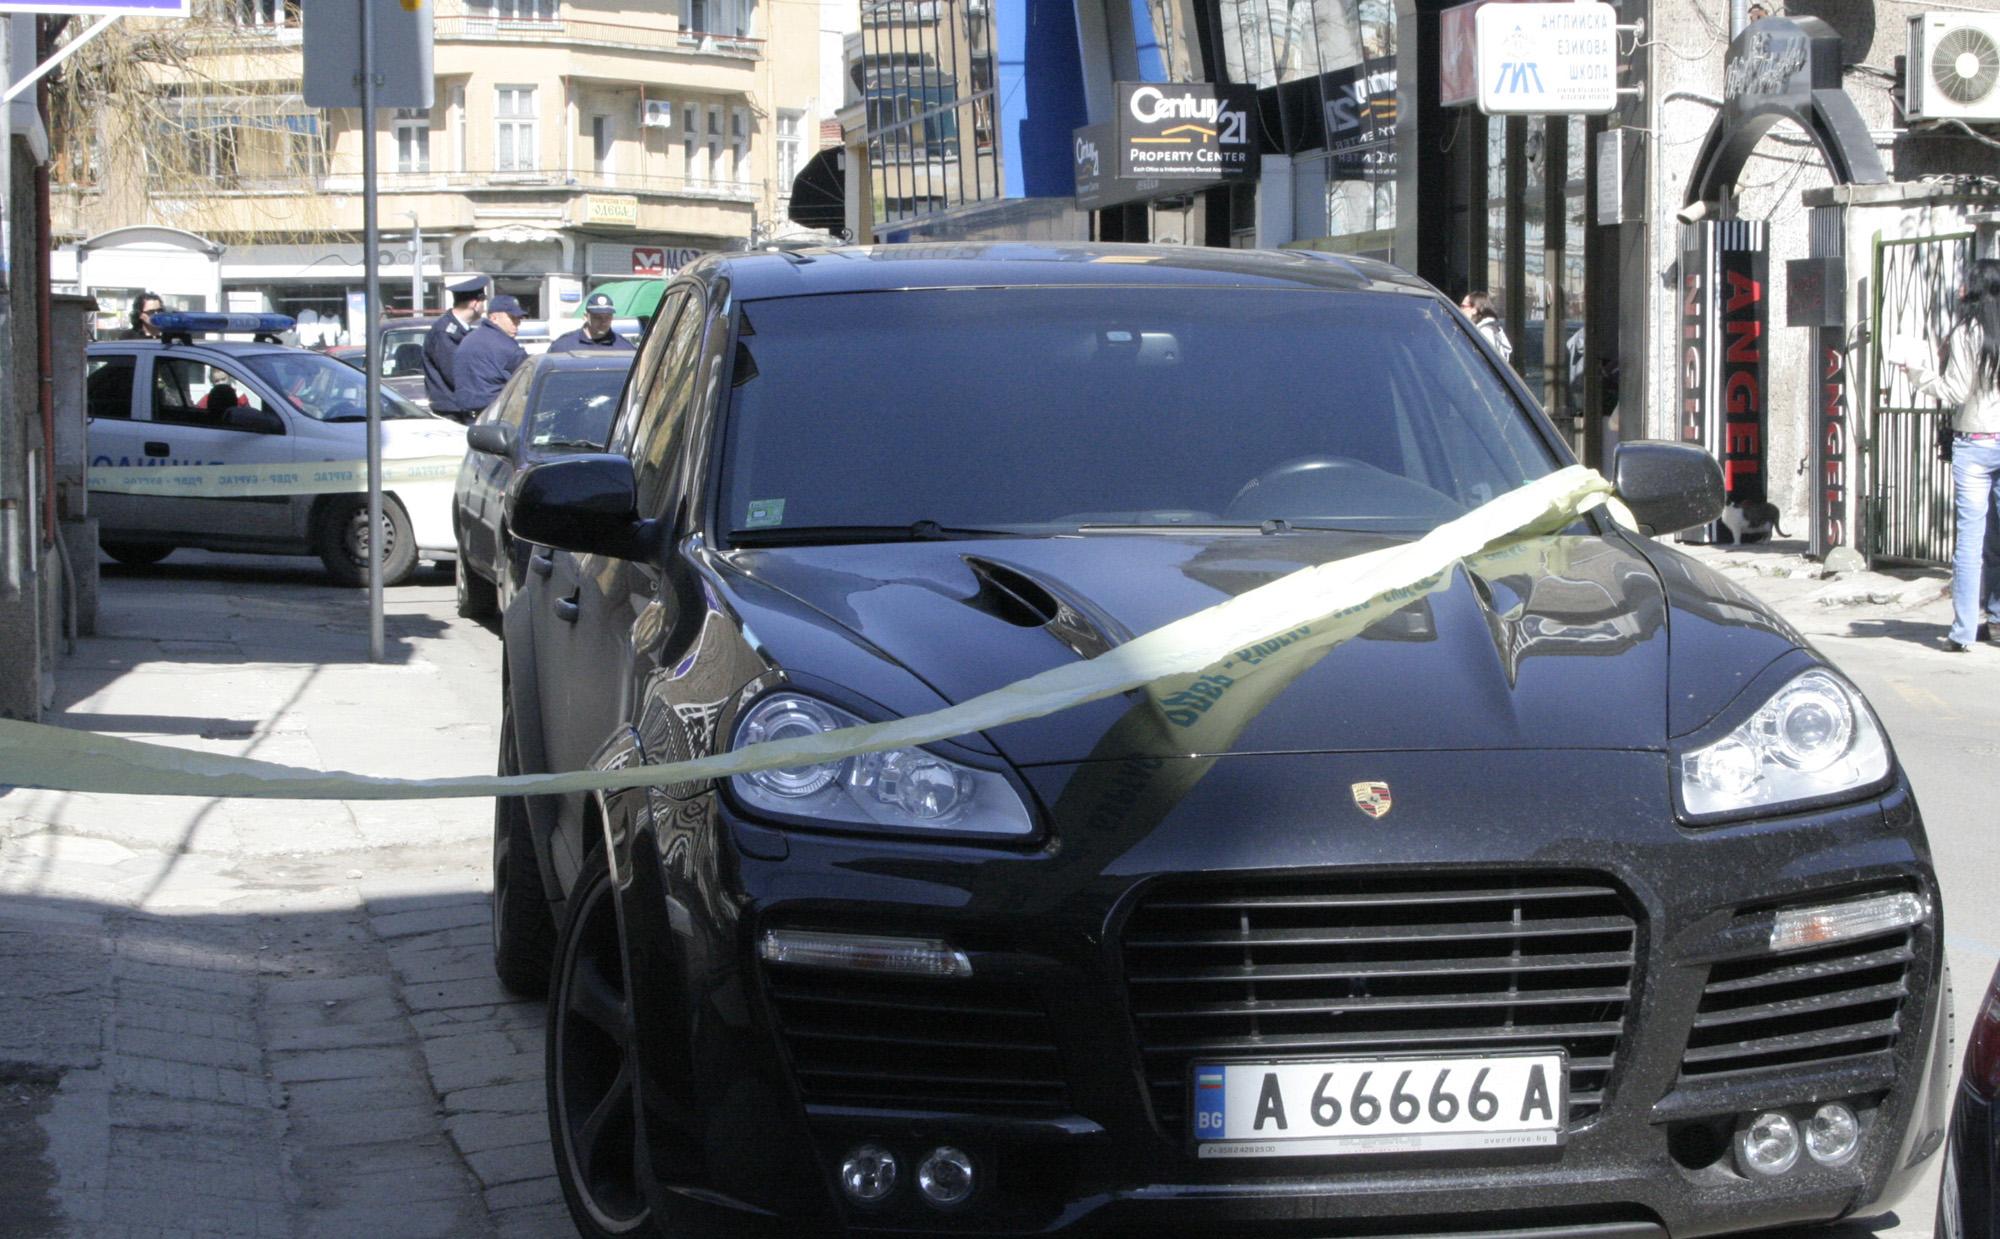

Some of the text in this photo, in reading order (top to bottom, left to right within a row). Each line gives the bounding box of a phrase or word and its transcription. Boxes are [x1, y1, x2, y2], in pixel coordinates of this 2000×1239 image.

[1569, 64, 1608, 80] ШКОЛА
[1218, 111, 1247, 144] 21
[1130, 148, 1246, 162] PROPERTY CENTER
[1825, 347, 1843, 546] ANGELS
[1199, 1063, 1553, 1130] BG A 66666 A
